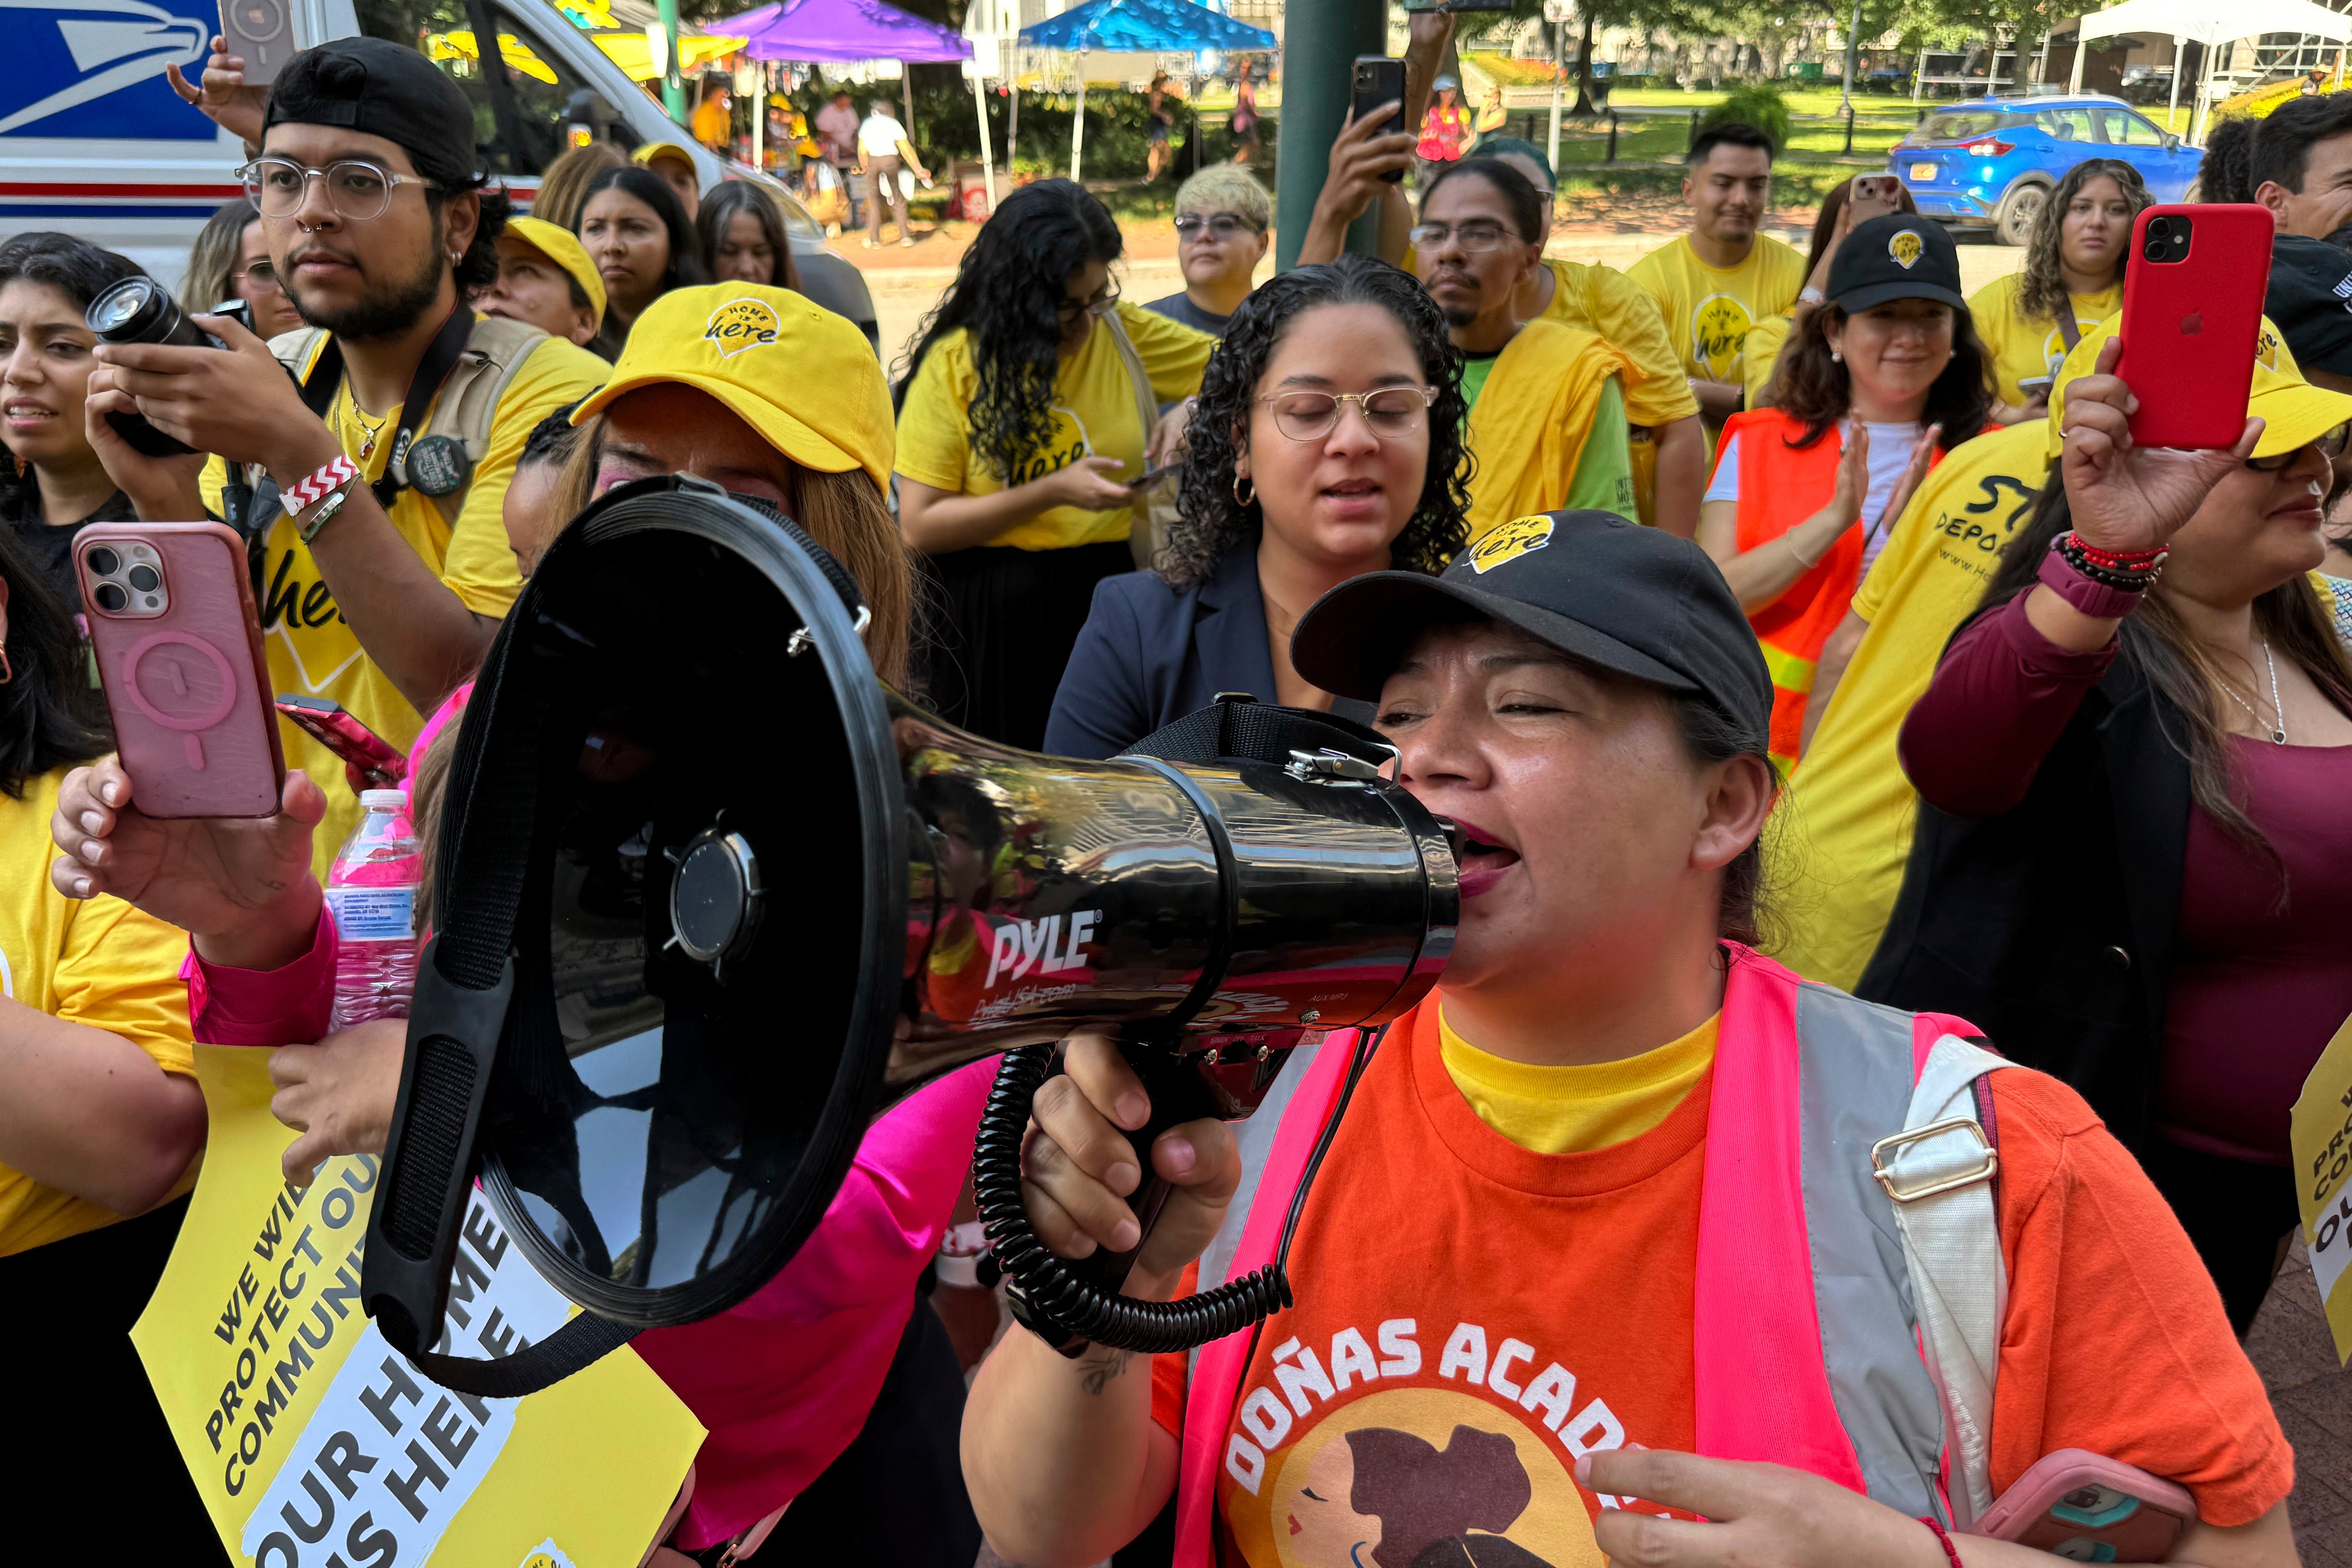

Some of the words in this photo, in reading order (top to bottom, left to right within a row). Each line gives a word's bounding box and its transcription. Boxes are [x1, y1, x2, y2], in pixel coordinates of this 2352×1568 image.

[705, 316, 776, 343] here
[729, 306, 769, 322] HOME
[1698, 325, 1746, 358] here
[1469, 533, 1548, 561] here
[264, 549, 346, 628] he
[2314, 1140, 2352, 1201] CO
[214, 1261, 260, 1345] WE
[253, 1155, 330, 1262] WIL
[205, 1223, 323, 1455] PROTECT
[320, 1153, 383, 1229] OU
[1225, 1317, 1422, 1497] DOÑAS
[255, 1430, 379, 1568] OUR
